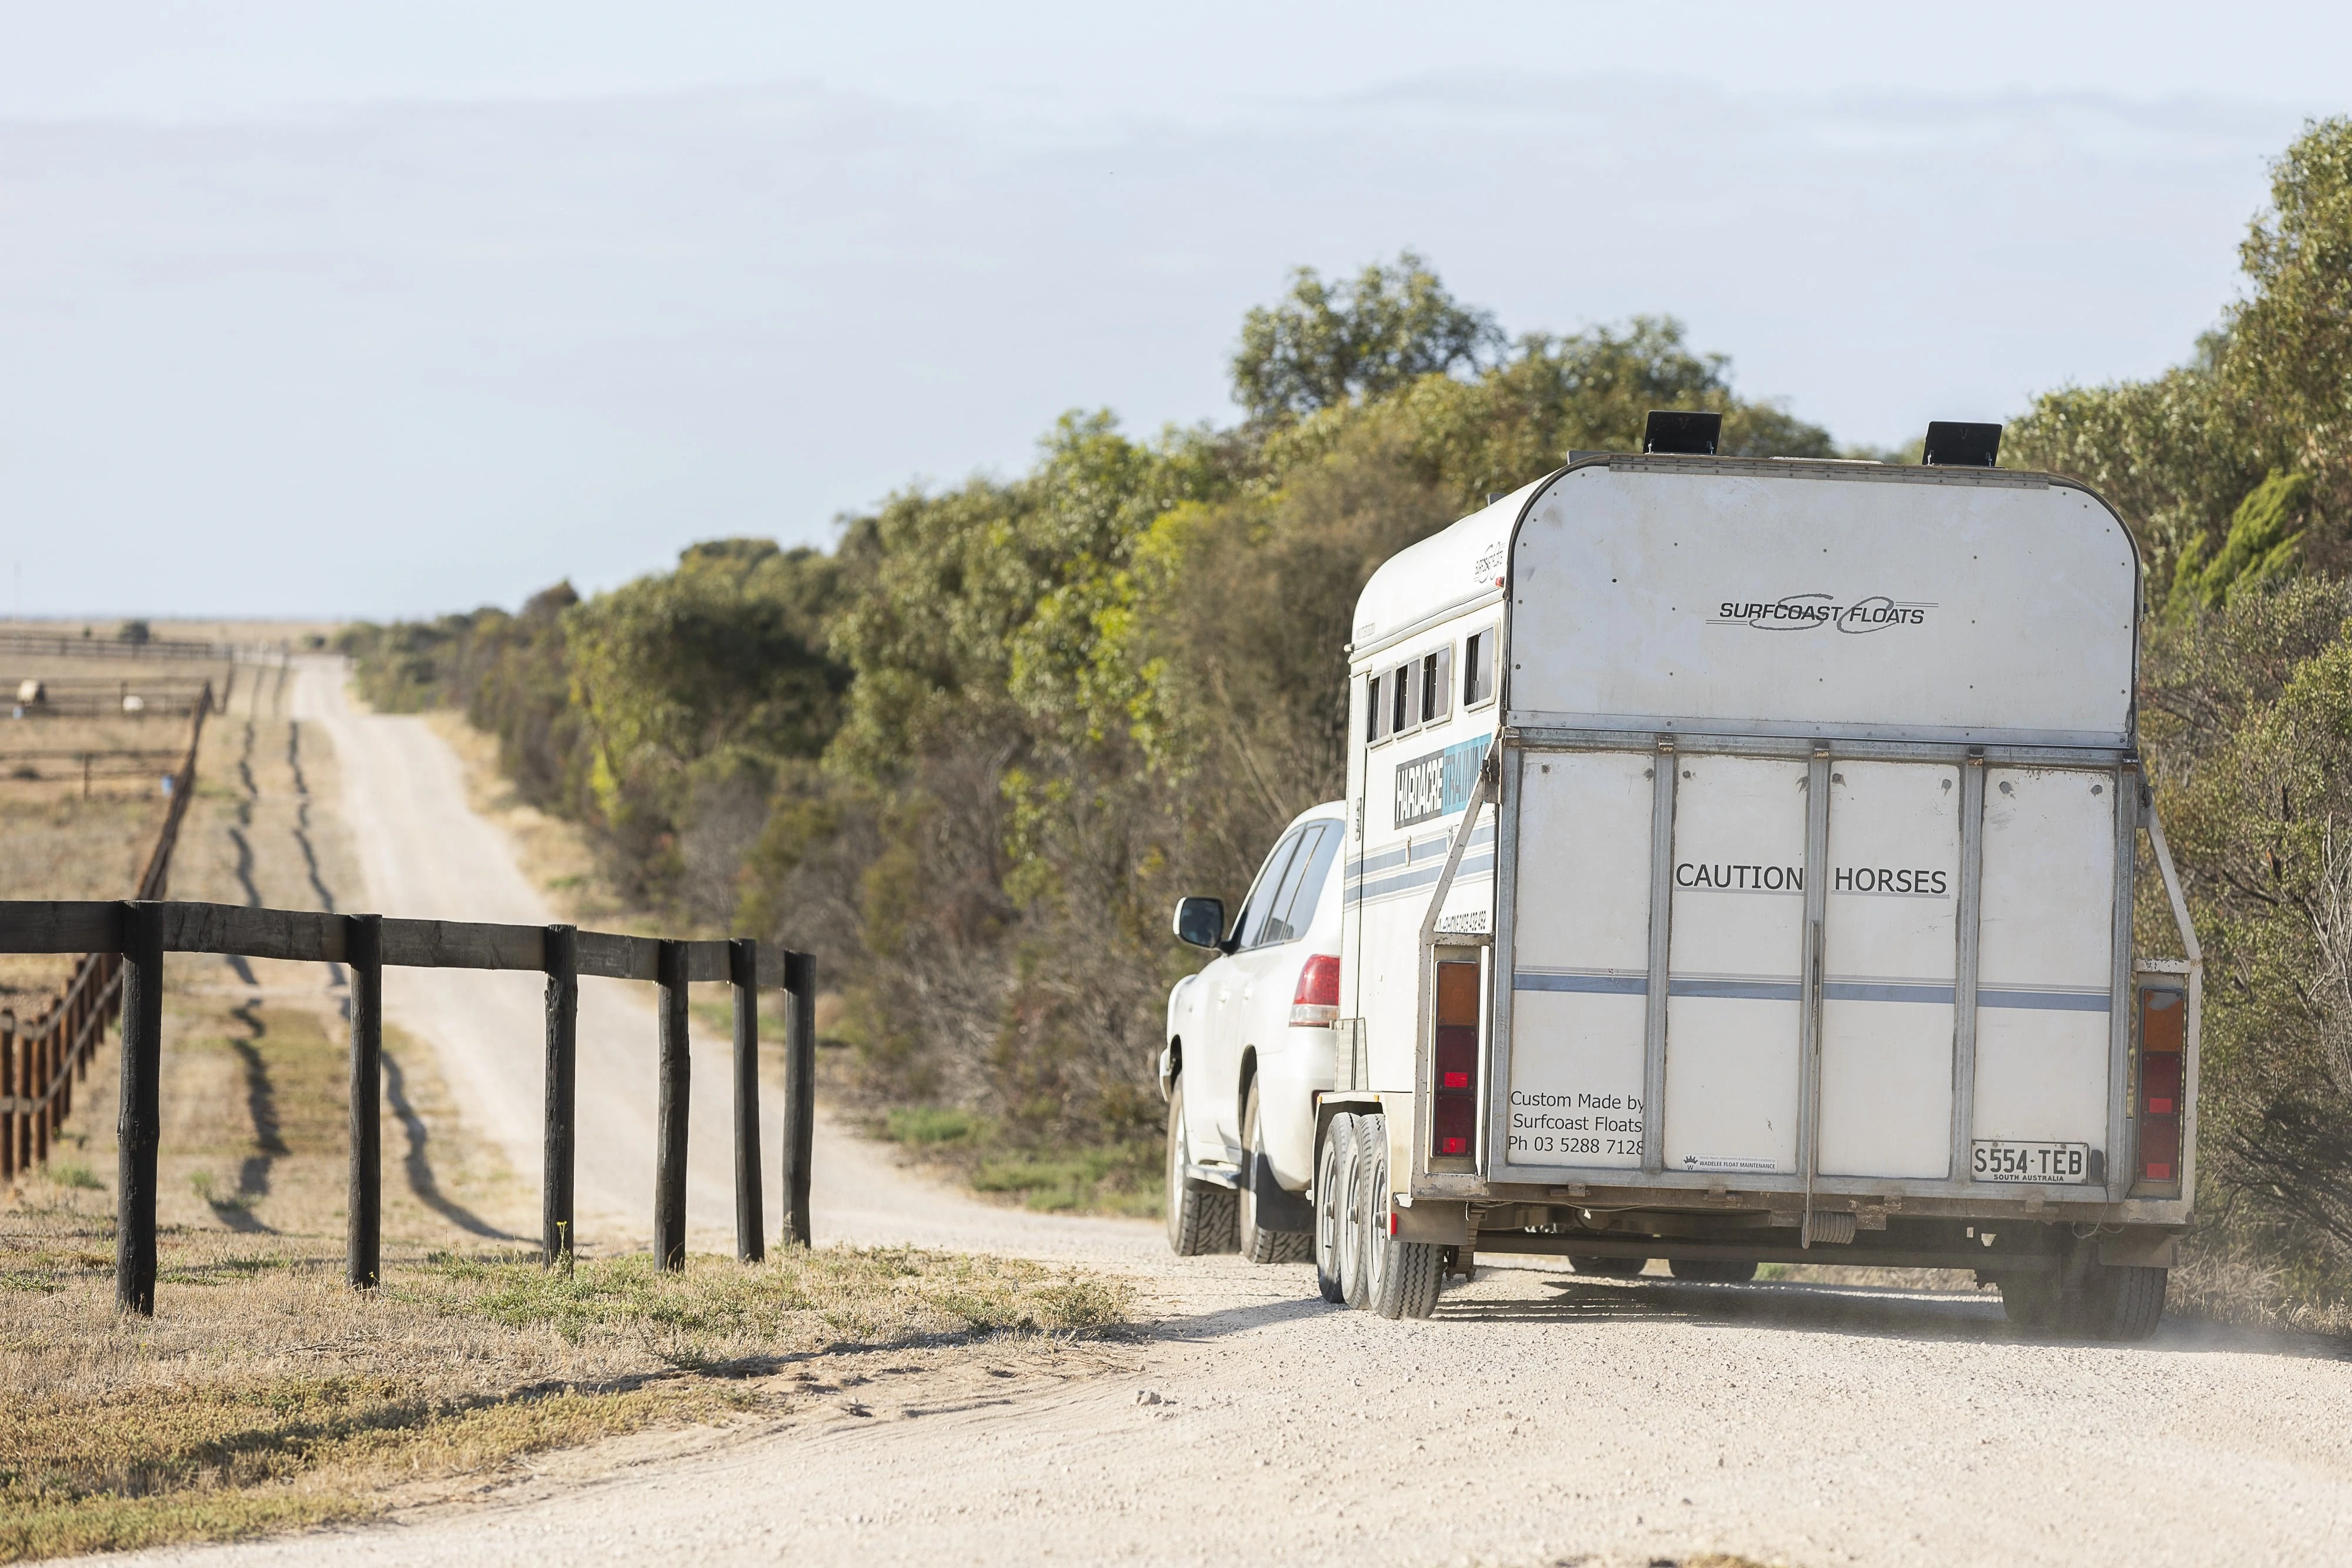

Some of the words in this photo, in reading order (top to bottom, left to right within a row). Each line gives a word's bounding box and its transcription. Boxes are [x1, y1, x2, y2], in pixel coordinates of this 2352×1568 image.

[1719, 602, 1843, 622] SURFCOAST
[1849, 607, 1925, 624] FLOATS
[1396, 757, 1443, 822] HARDACRE
[1445, 743, 1490, 806] TRAININ
[1676, 862, 1804, 890] CAUTION
[1835, 867, 1947, 894] HORSES
[1511, 1091, 1572, 1107] Custom
[1578, 1093, 1622, 1109] Made
[1627, 1094, 1645, 1114] by
[1512, 1113, 1589, 1131] Surfcoast
[1595, 1116, 1643, 1133] Floats
[1508, 1135, 1528, 1151] Ph
[1534, 1136, 1553, 1152] 03
[1560, 1138, 1600, 1154] 5288
[1606, 1139, 1644, 1155] 7128
